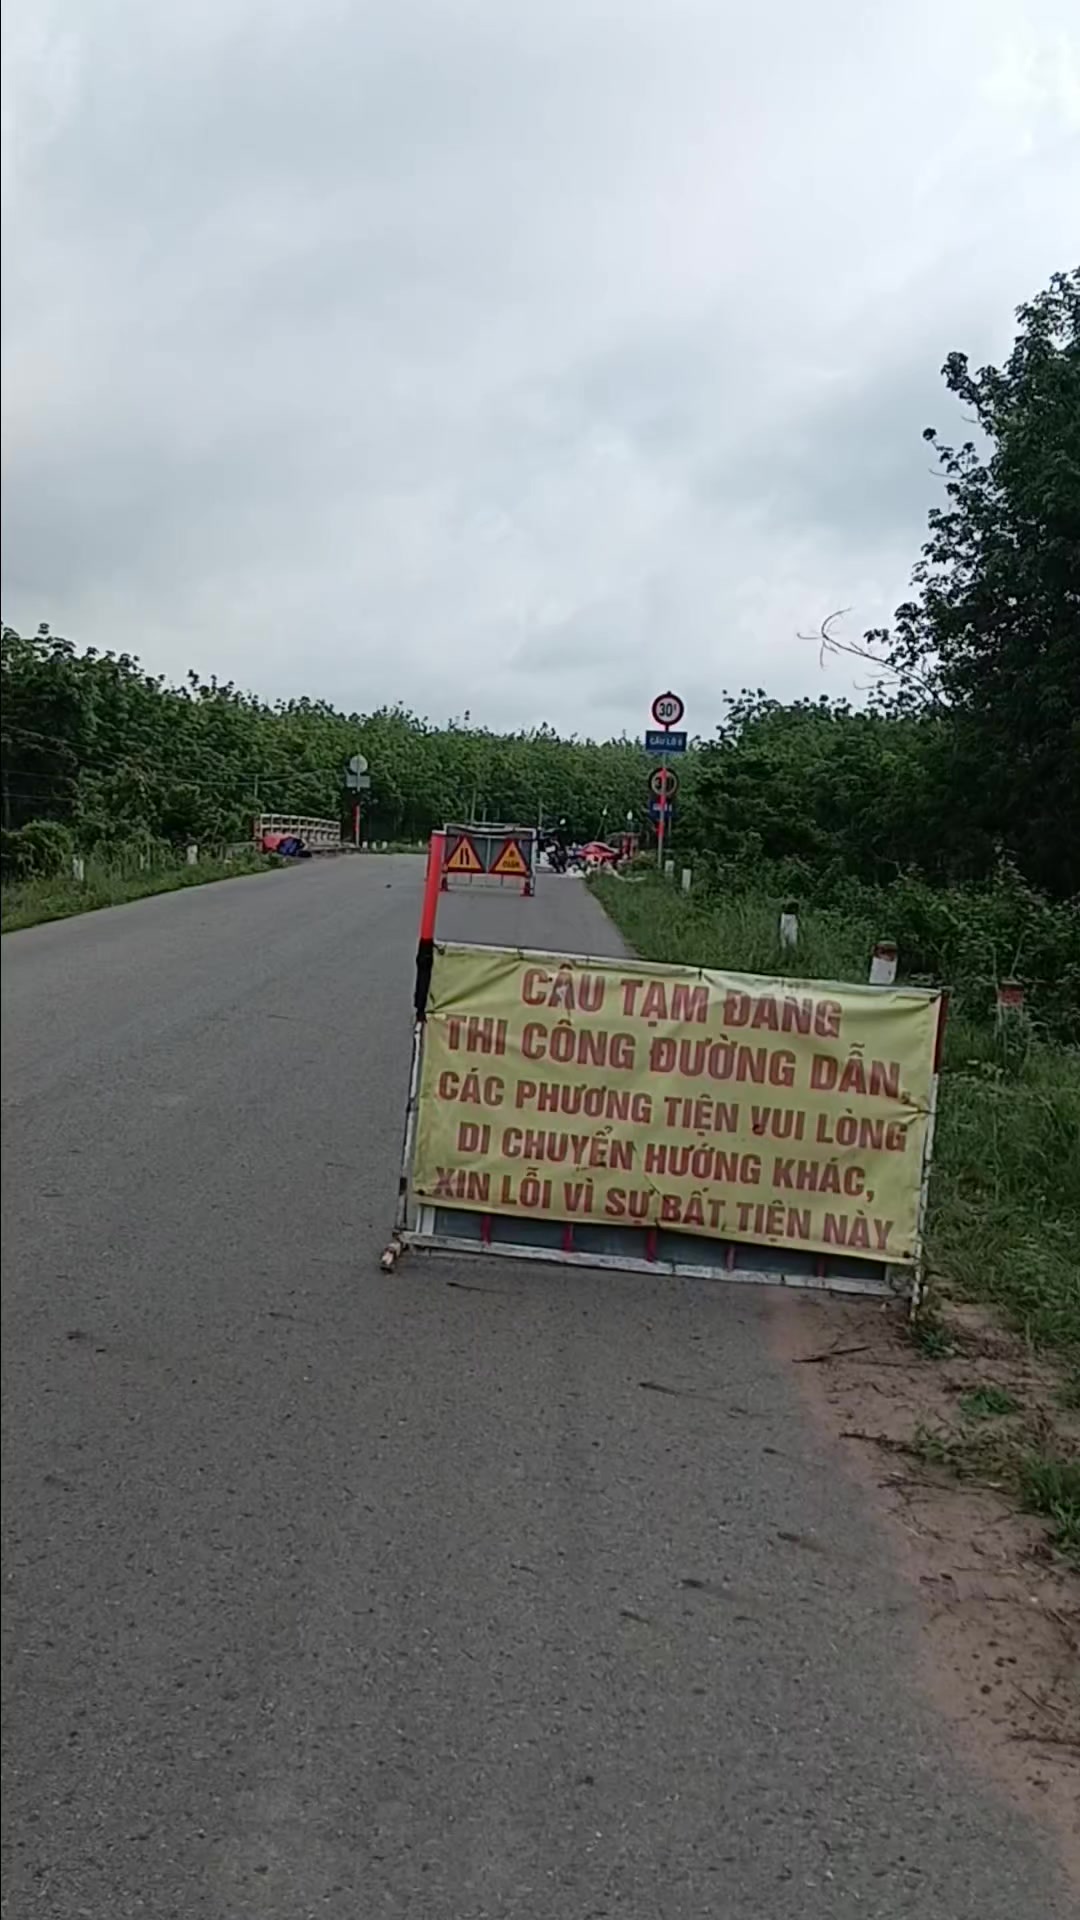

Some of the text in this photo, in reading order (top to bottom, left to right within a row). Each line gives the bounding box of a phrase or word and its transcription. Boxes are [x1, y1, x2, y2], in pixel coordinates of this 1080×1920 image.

[621, 977, 709, 1027] TẠM
[723, 988, 842, 1038] ĐANG
[446, 1014, 508, 1056] THI
[522, 1019, 636, 1070] CÔNG
[649, 1034, 796, 1088] ĐƯỜNG
[438, 1068, 908, 1153] CÁC PHƯƠNG TIỆN VUI LÒNG
[457, 1121, 875, 1203] DI CHUYỂN HƯỚNG KHÁC,
[434, 1166, 893, 1250] XIN LỖI VÌ SỰ BẤT TIỆN NÀY
